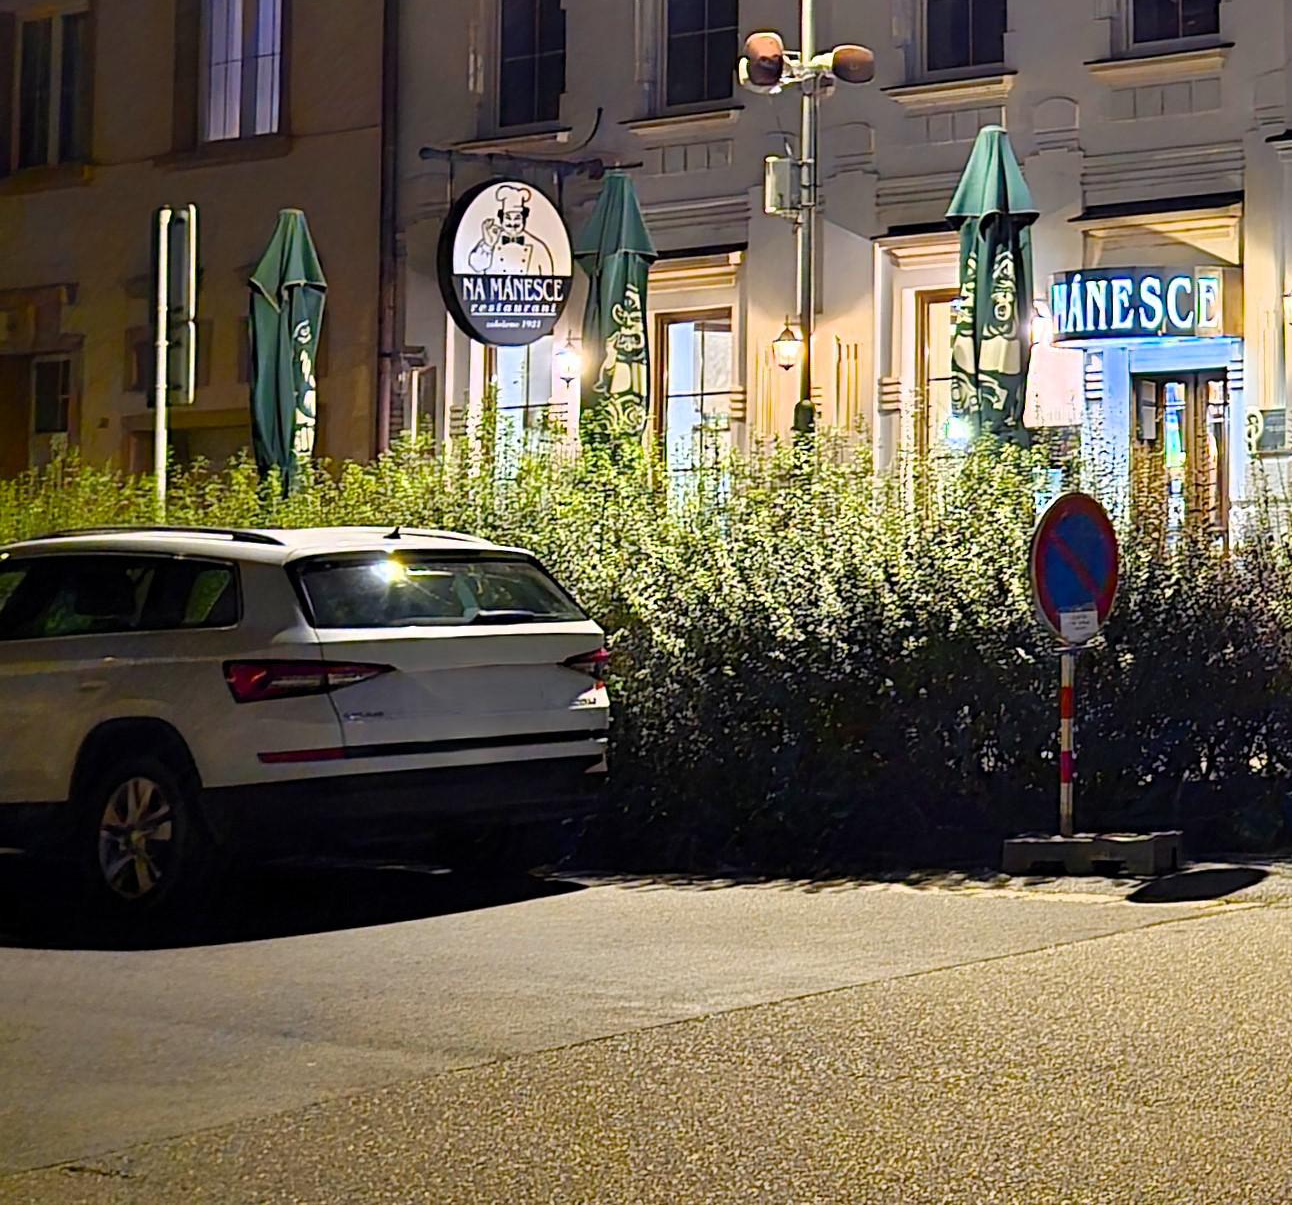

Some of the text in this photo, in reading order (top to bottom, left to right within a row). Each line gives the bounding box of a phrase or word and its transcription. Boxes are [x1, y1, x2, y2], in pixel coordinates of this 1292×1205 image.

[463, 275, 563, 301] NA MÁNESCE
[471, 302, 557, 313] restaurant
